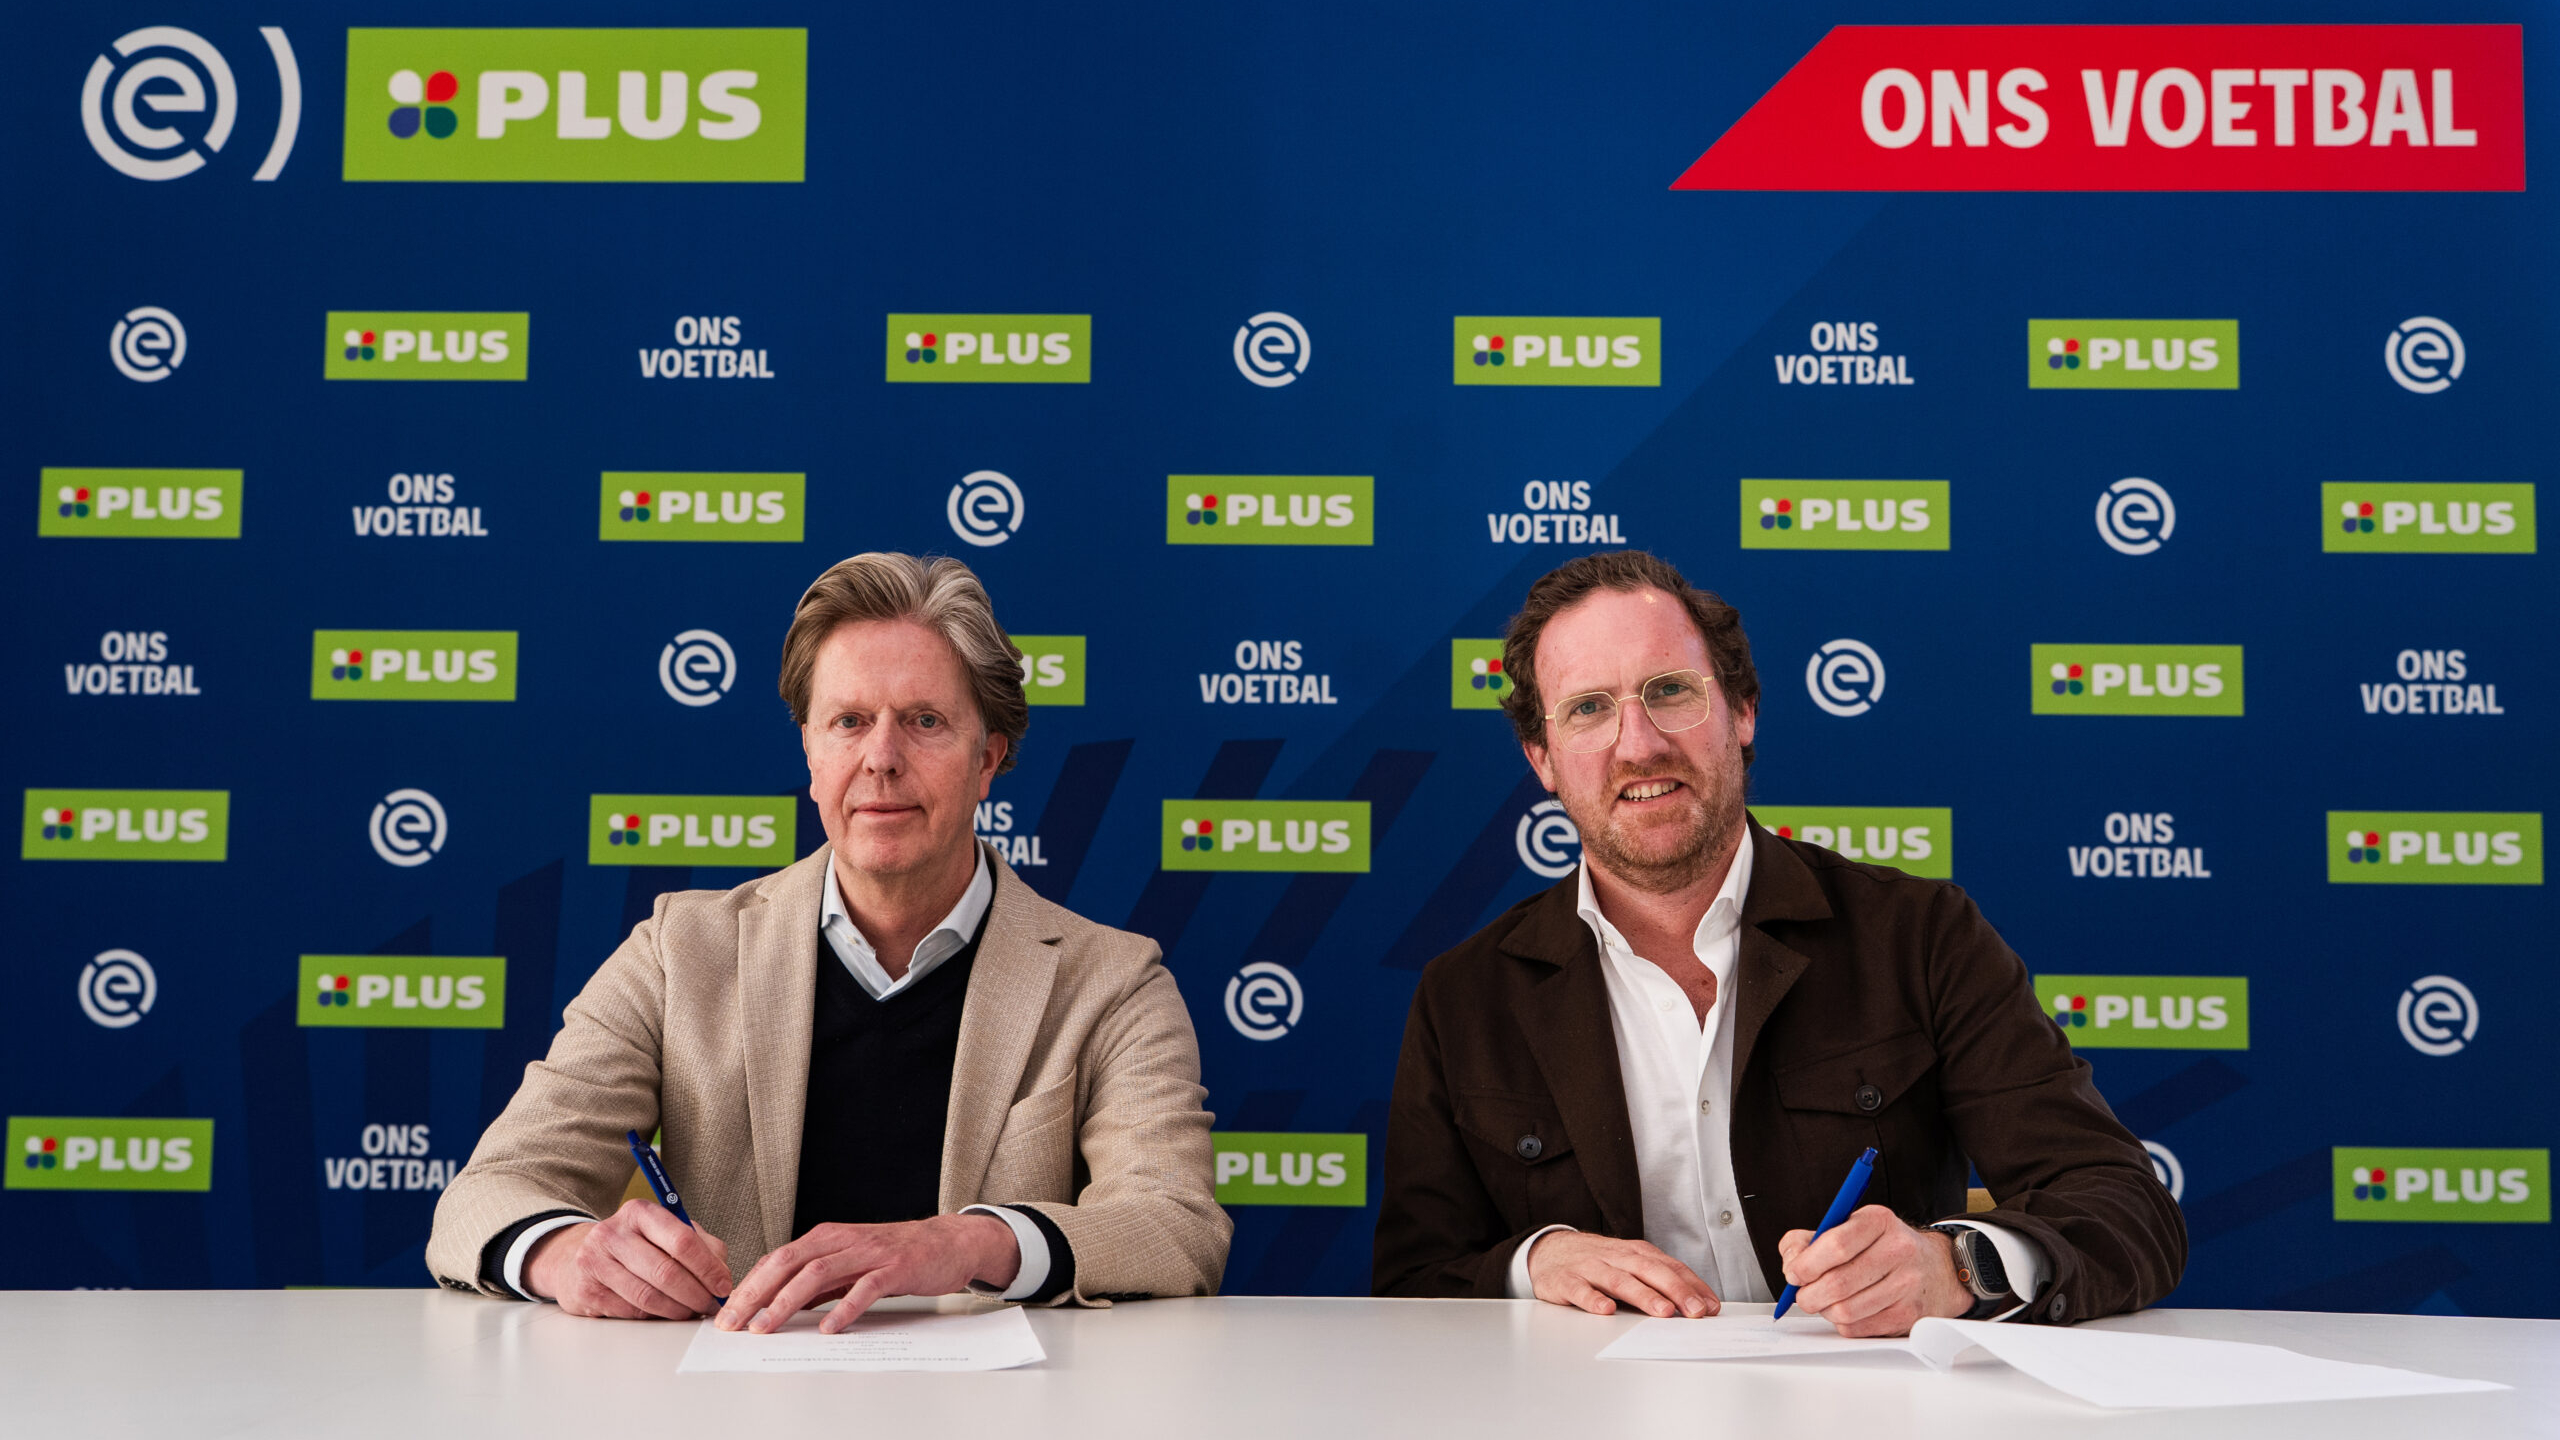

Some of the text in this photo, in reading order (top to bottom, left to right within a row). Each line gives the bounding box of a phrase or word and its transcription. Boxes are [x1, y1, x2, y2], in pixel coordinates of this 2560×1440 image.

[476, 70, 762, 141] PLUS
[1861, 67, 2477, 149] ONS VOETBAL
[382, 330, 510, 363] PLUS
[675, 316, 741, 346] ONS
[1810, 321, 1878, 352] ONS
[639, 348, 775, 379] VOETBAL
[944, 332, 1072, 365] PLUS
[1512, 335, 1642, 369] PLUS
[2087, 337, 2219, 371] PLUS
[1774, 354, 1914, 385] VOETBAL
[97, 487, 223, 521] PLUS
[388, 473, 455, 504] ONS
[1523, 480, 1591, 511] ONS
[352, 506, 488, 537] VOETBAL
[658, 490, 786, 524] PLUS
[1225, 494, 1355, 528] PLUS
[1799, 498, 1931, 533] PLUS
[2382, 501, 2516, 535] PLUS
[1487, 513, 1627, 544] VOETBAL
[101, 631, 167, 662] ONS
[1235, 640, 1302, 671] ONS
[65, 664, 200, 695] VOETBAL
[370, 649, 498, 683] PLUS
[2091, 663, 2224, 698] PLUS
[2397, 649, 2466, 681] ONS
[1199, 673, 1338, 704] VOETBAL
[2361, 683, 2504, 714] VOETBAL
[80, 808, 209, 843] PLUS
[648, 814, 777, 848] PLUS
[973, 801, 1013, 832] NS
[2105, 812, 2174, 844] ONS
[1221, 819, 1351, 854] PLUS
[1800, 825, 1932, 860] PLUS
[2388, 831, 2523, 866] PLUS
[2068, 846, 2211, 878] VOETBAL
[356, 975, 486, 1010] PLUS
[2095, 995, 2228, 1030] PLUS
[63, 1137, 193, 1172] PLUS
[362, 1124, 429, 1156] ONS
[1216, 1152, 1346, 1187] PLUS
[2394, 1168, 2530, 1203] PLUS
